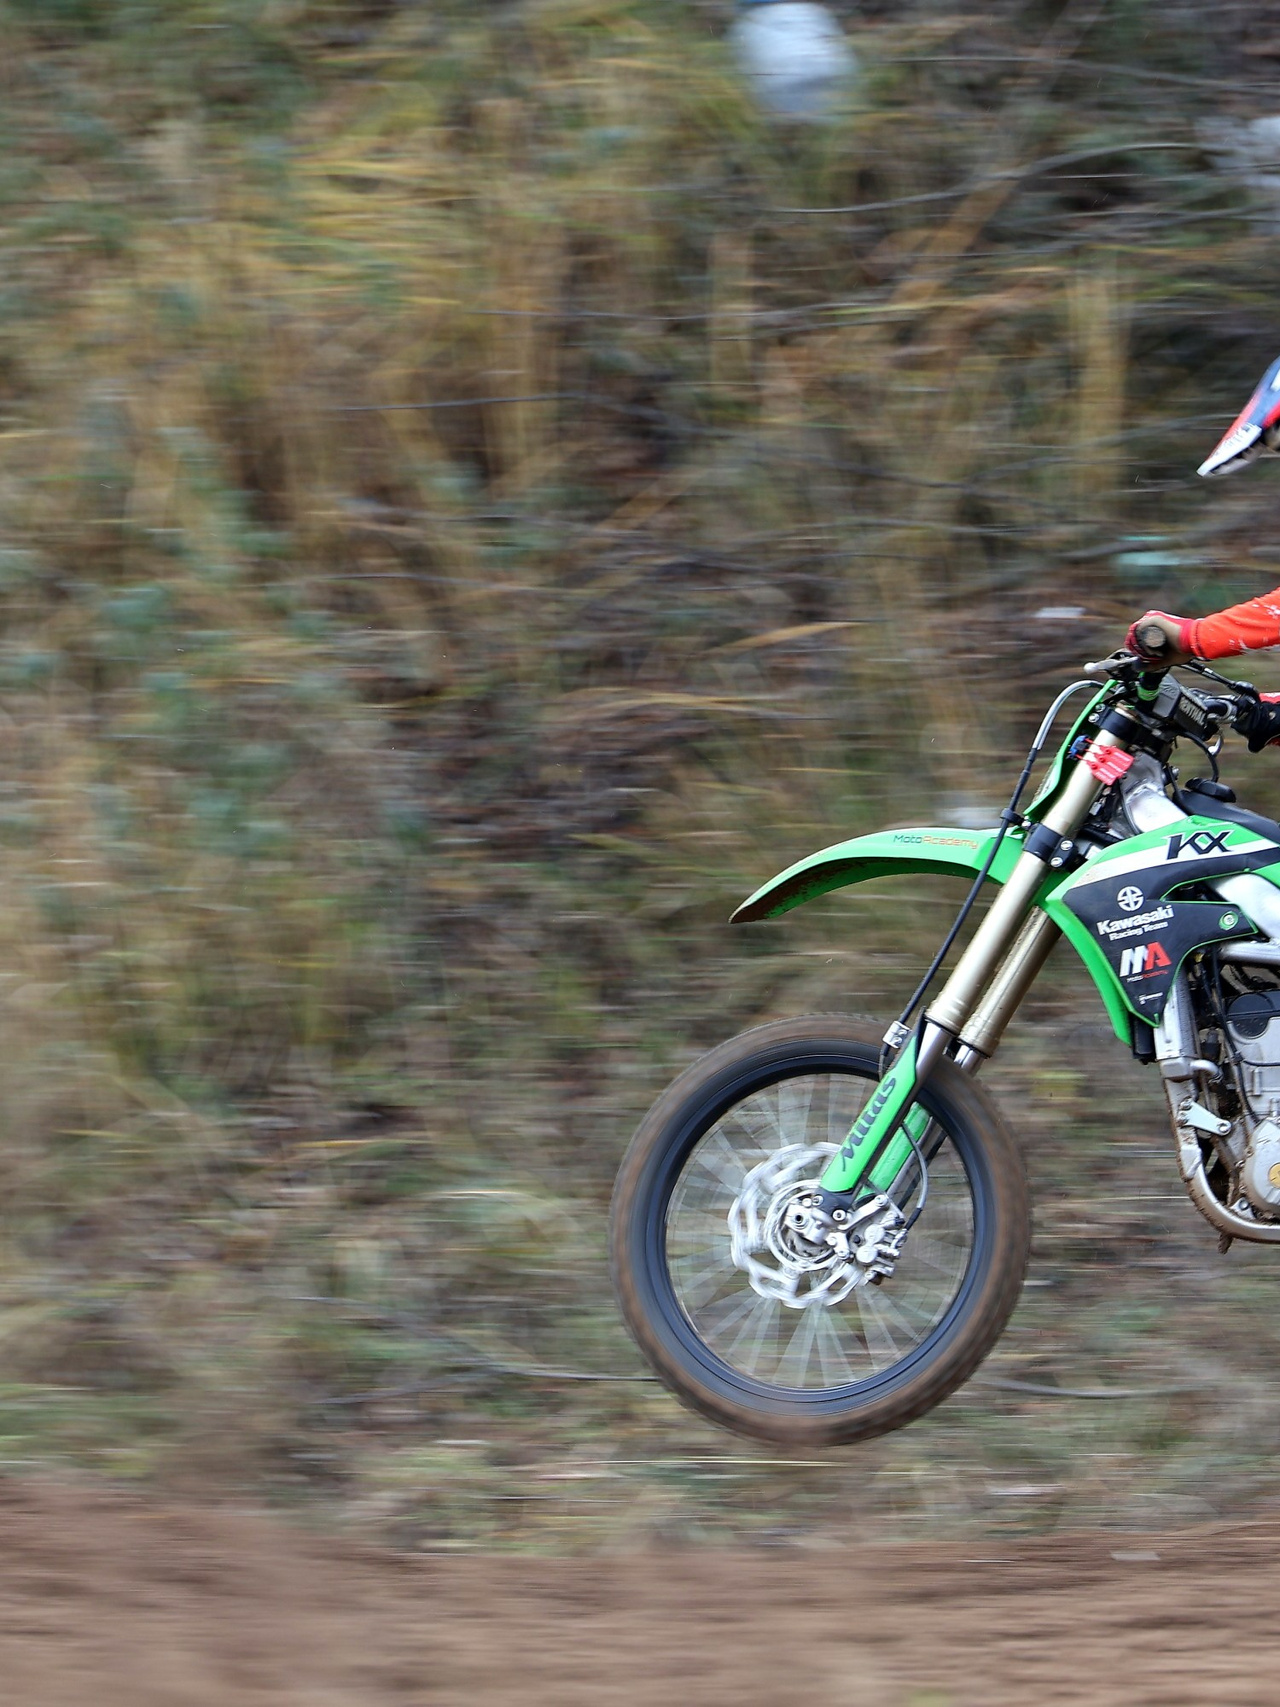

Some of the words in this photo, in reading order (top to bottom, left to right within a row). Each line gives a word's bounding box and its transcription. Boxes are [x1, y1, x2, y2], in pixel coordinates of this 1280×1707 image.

[892, 834, 978, 850] MotoAcademy
[1166, 830, 1234, 860] KX
[1096, 904, 1175, 936] Kawasaki
[1108, 927, 1144, 941] Racing
[1141, 921, 1169, 932] Team
